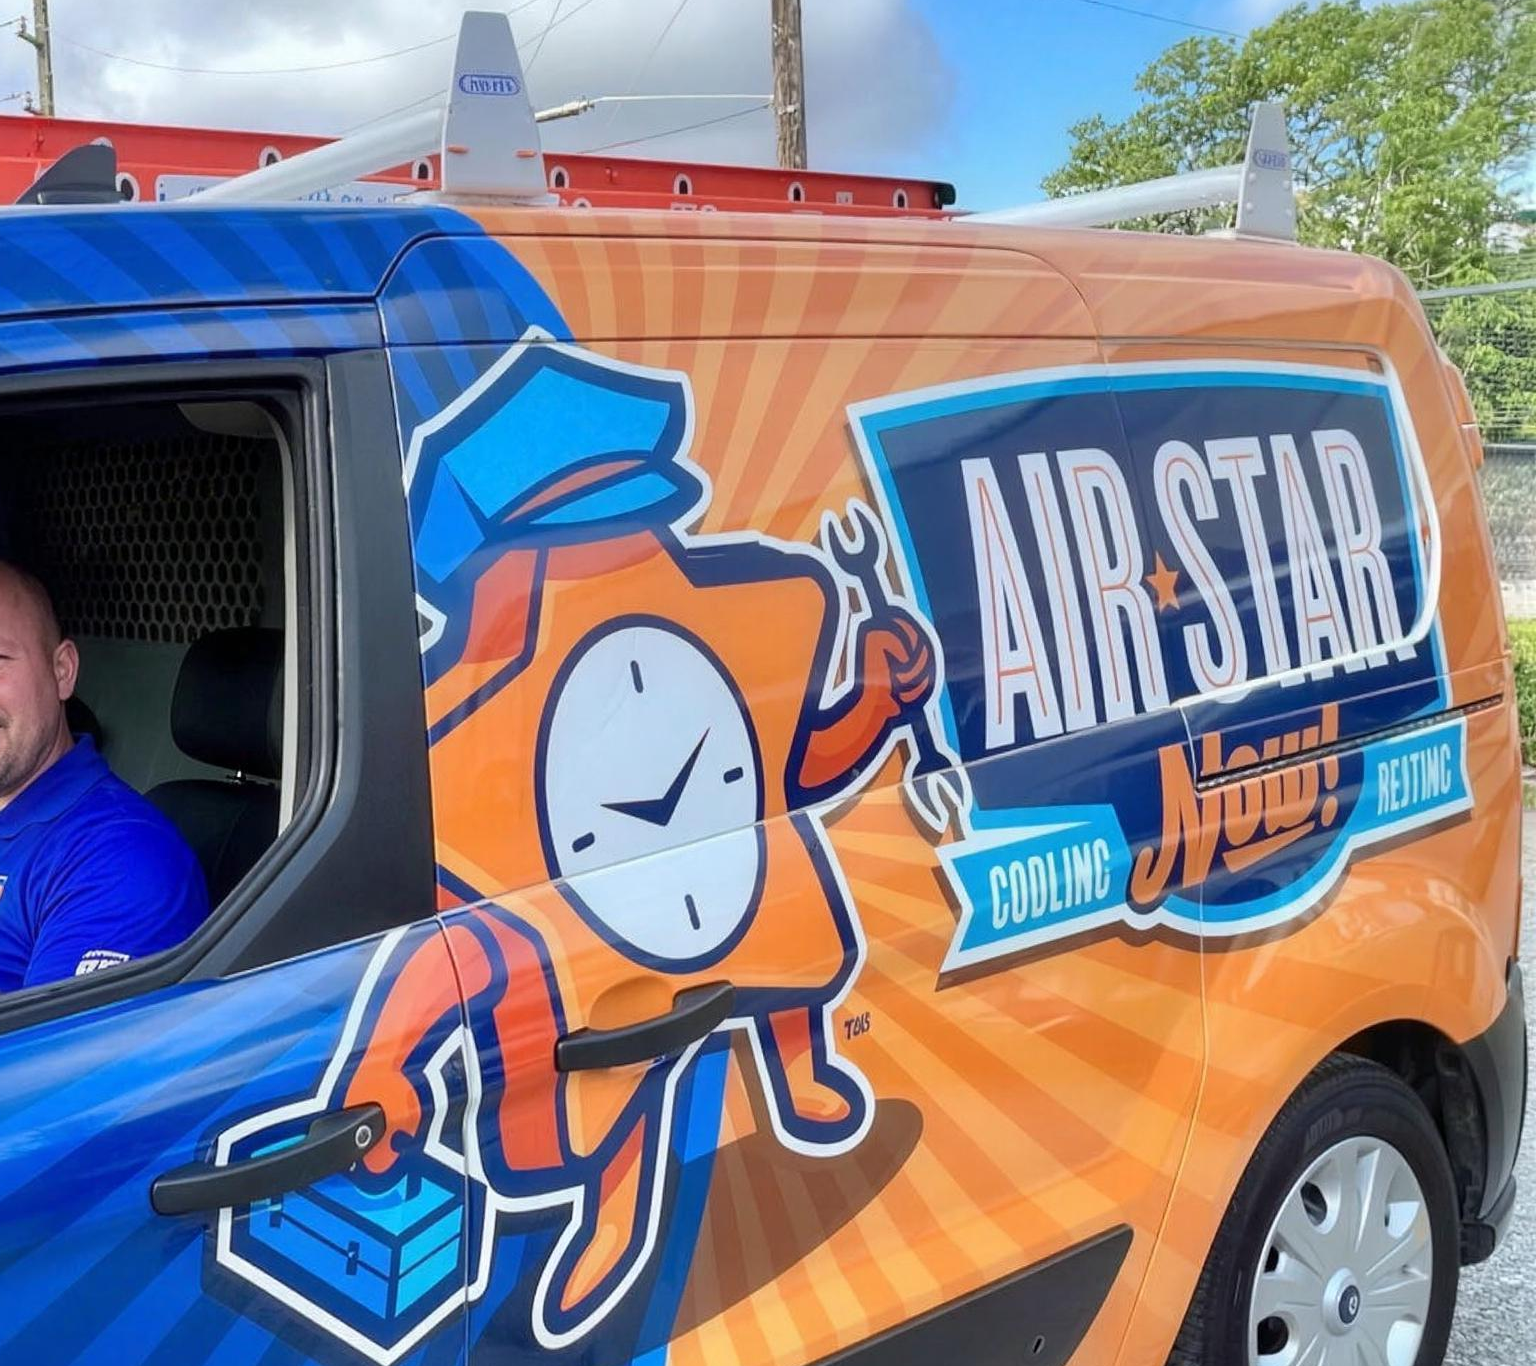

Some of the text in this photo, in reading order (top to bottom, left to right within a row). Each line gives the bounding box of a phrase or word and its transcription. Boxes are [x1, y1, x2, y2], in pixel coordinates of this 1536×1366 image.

[961, 428, 1421, 751] AIR STAR
[1130, 702, 1340, 905] Now!
